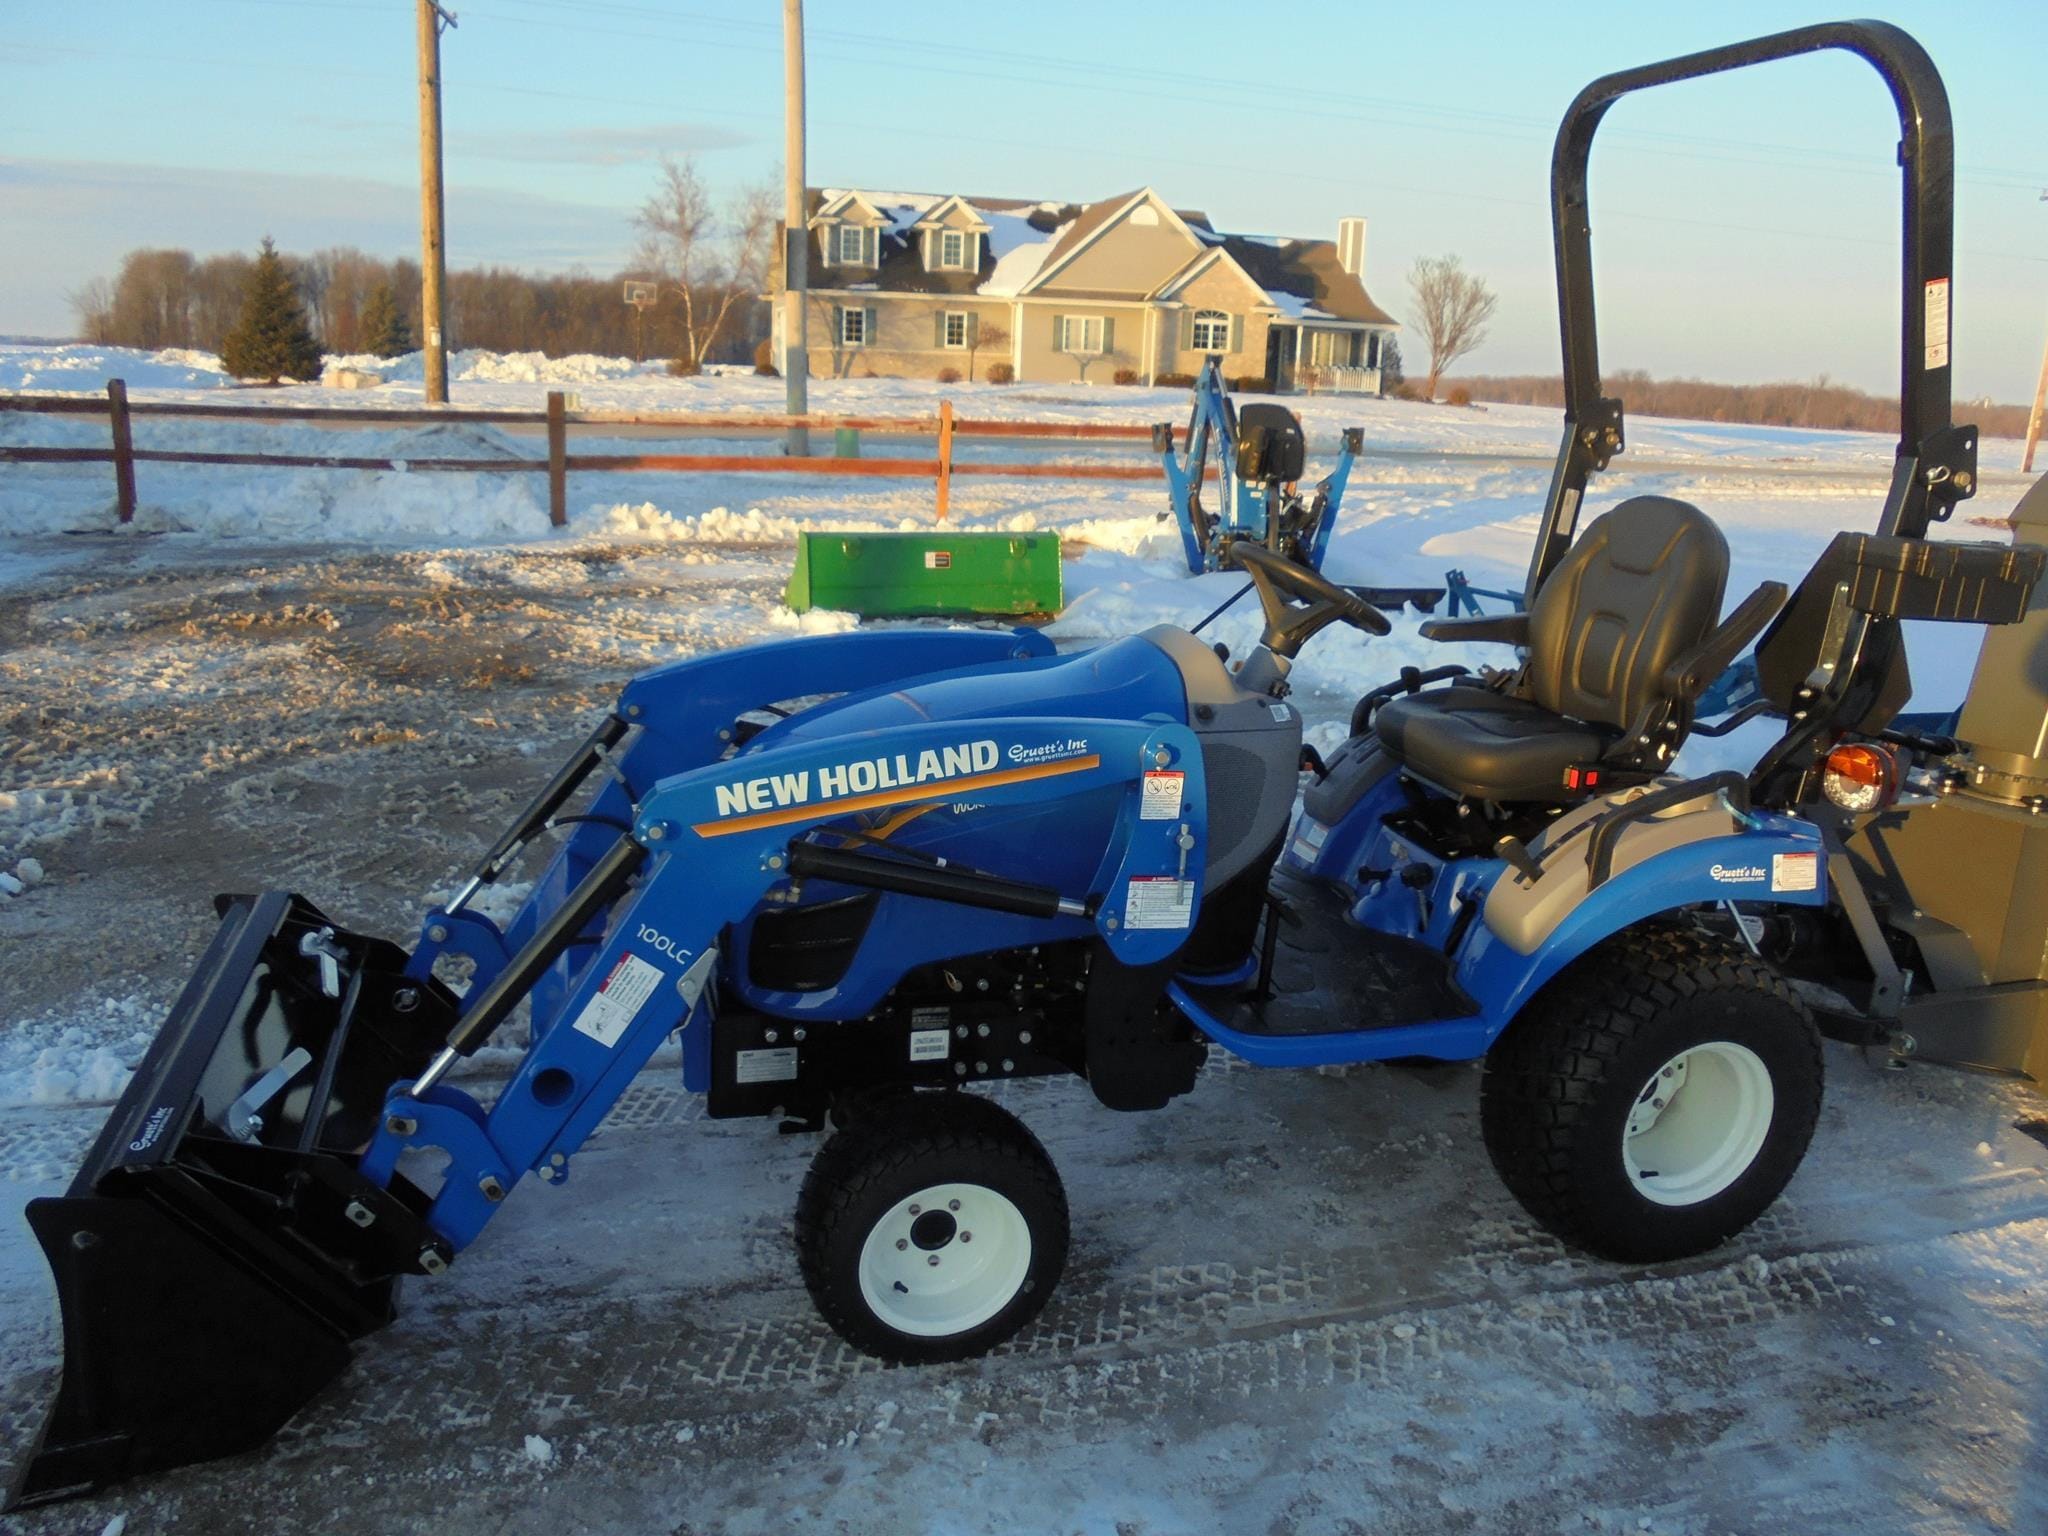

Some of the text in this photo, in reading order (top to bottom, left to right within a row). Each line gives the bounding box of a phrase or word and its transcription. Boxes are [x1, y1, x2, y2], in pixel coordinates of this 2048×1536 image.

[1008, 739, 1088, 762] Gruett's Inc
[715, 739, 1000, 817] NEW HOLLAND
[1751, 866, 1767, 877] Inc
[637, 923, 693, 965] 100LC
